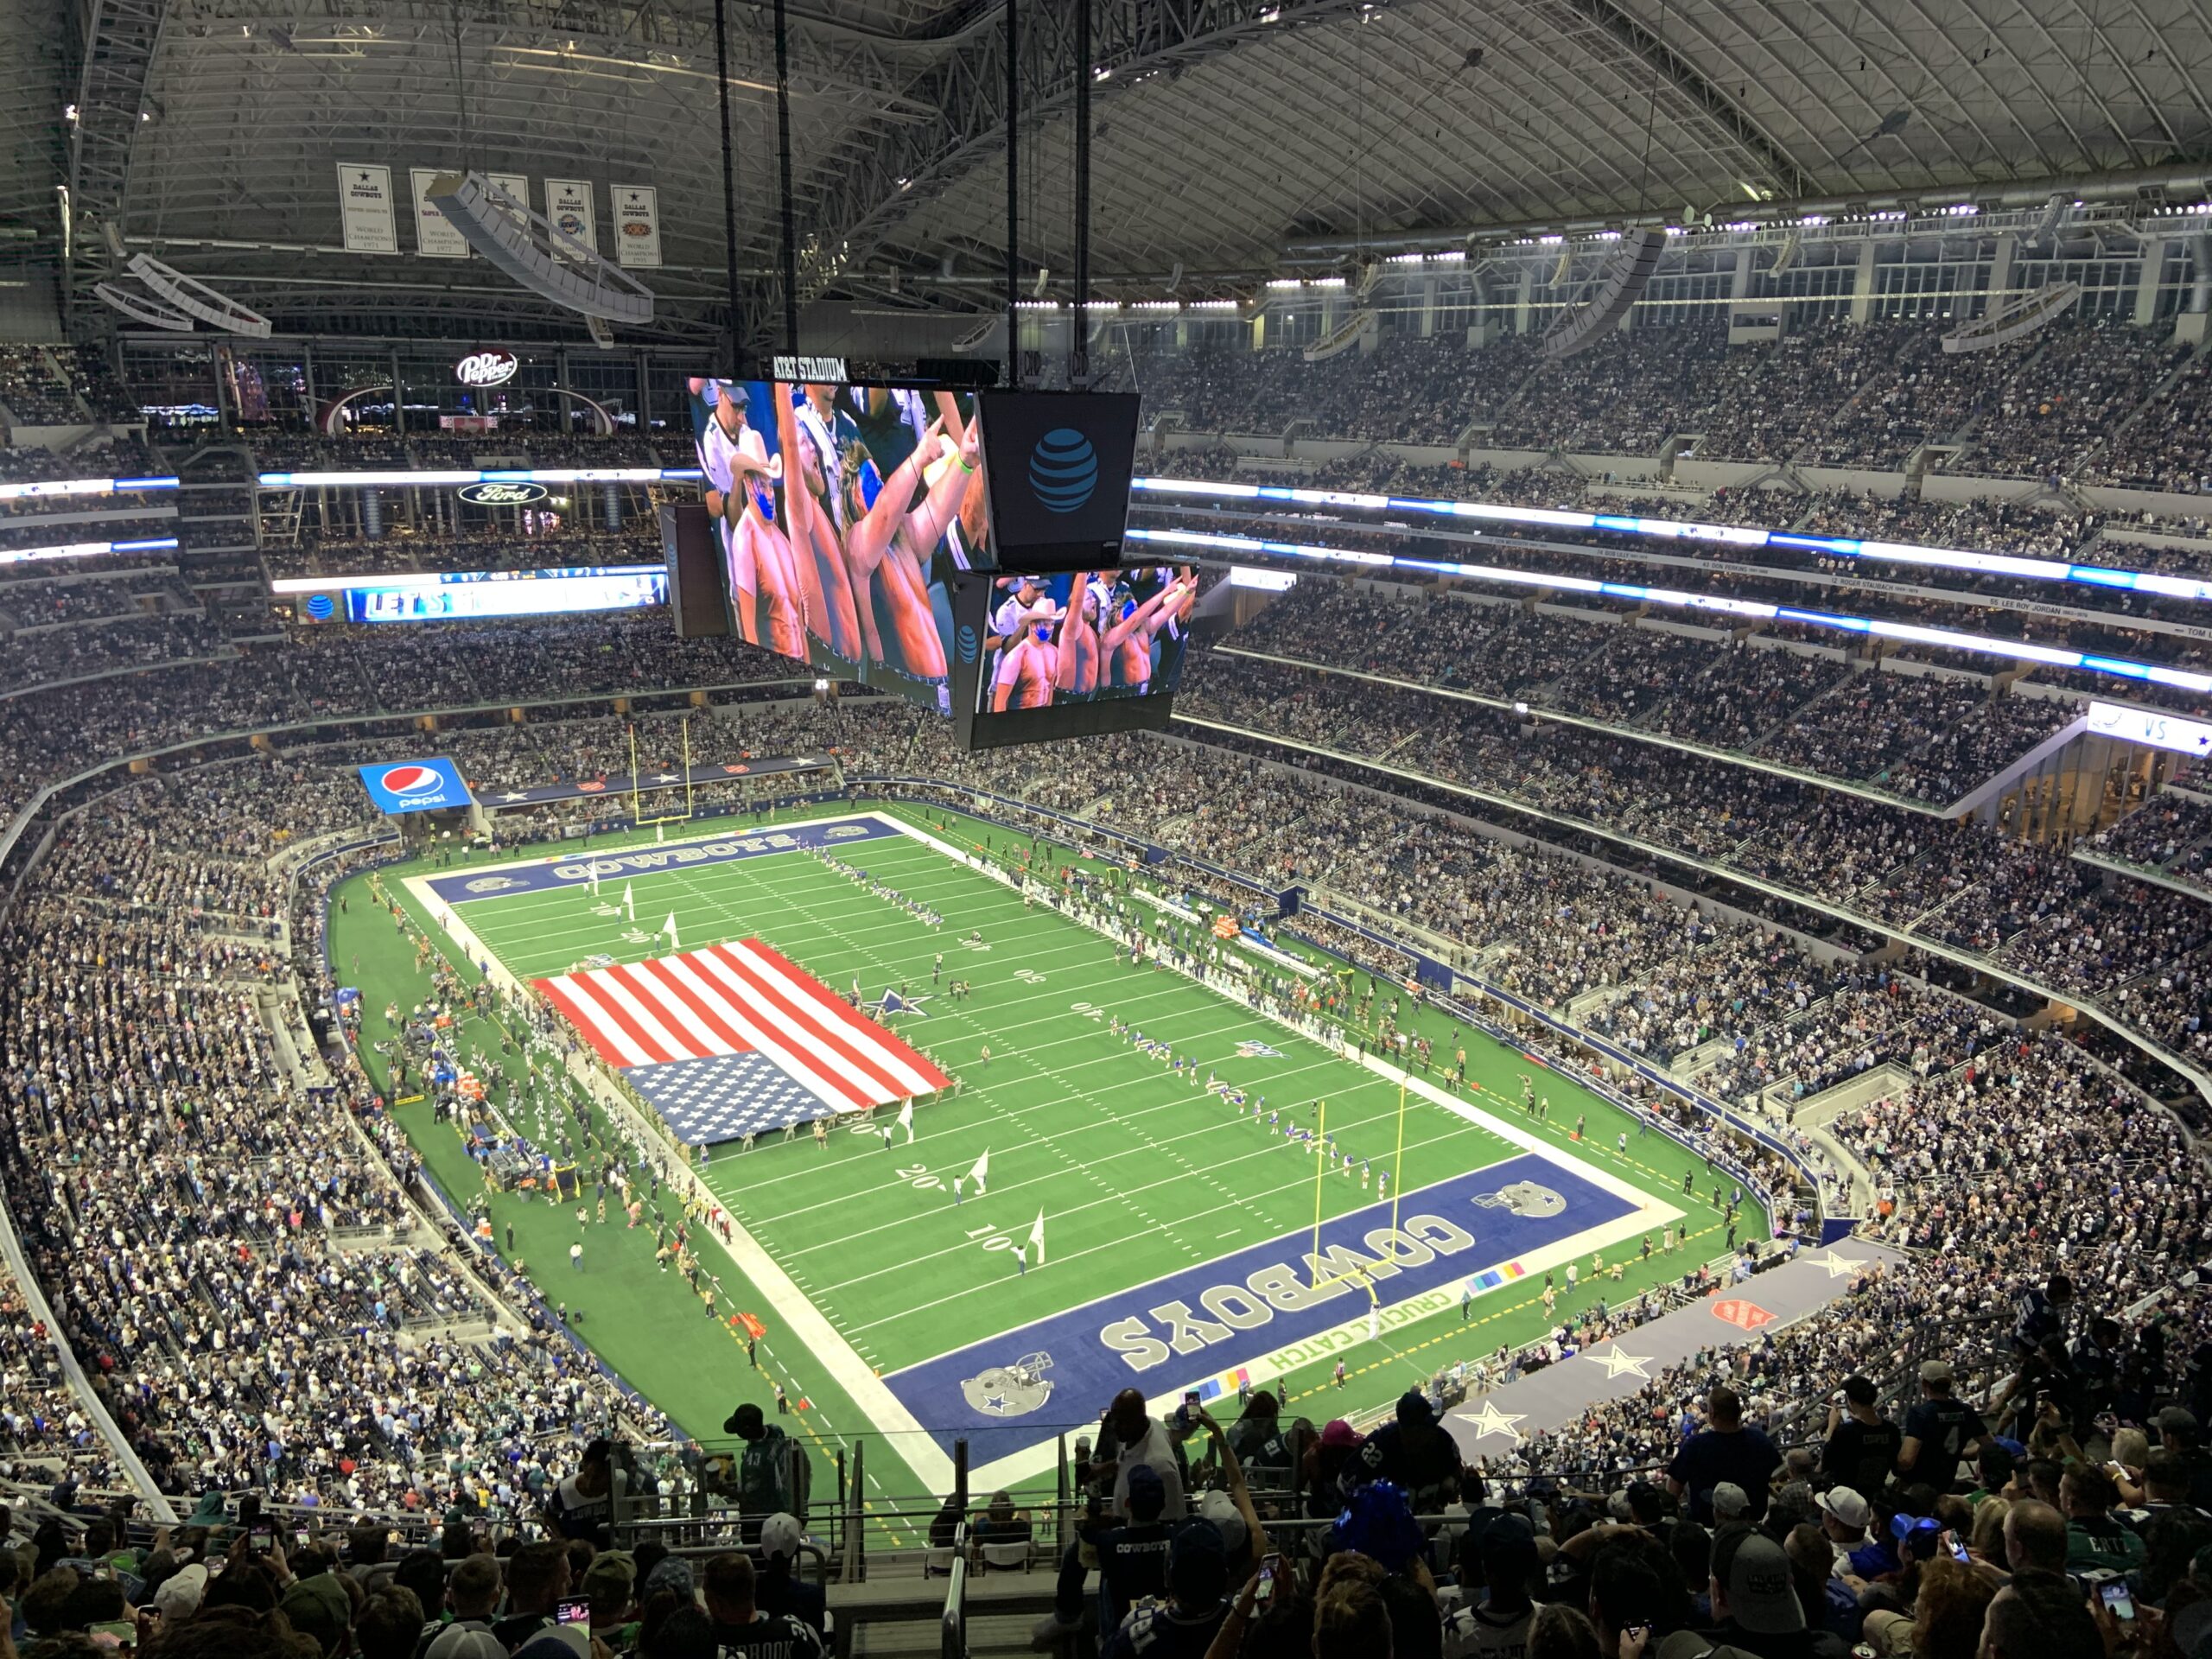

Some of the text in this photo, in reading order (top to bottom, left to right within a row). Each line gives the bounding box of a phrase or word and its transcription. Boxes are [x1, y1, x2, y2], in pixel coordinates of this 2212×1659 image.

[348, 233, 392, 242] CHAMPIONS
[423, 238, 464, 246] CHAMPIONS
[480, 353, 501, 367] Dr
[463, 356, 513, 383] Pepper
[773, 356, 848, 381] AT&T STADIUM
[476, 485, 531, 500] Ford
[1724, 563, 1747, 573] PERKINS
[1840, 578, 1861, 587] ROGER
[1862, 581, 1893, 591] STAUBACH
[2001, 600, 2014, 608] LEE
[2016, 601, 2030, 610] ROY
[2031, 604, 2061, 614] JORDAN
[2188, 627, 2206, 637] TOM
[2145, 717, 2167, 740] VS
[398, 793, 446, 809] pepsi
[553, 834, 799, 880] COWBOYS
[1013, 969, 1047, 984] 50
[1070, 1001, 1105, 1016] 40
[895, 1163, 940, 1189] 20
[964, 1223, 1013, 1251] 10
[1099, 1214, 1476, 1374] COWBOYS
[1268, 1332, 1355, 1370] CATCH
[746, 1452, 762, 1466] 43
[1361, 1441, 1383, 1469] 22
[1116, 1539, 1171, 1554] COWBOYS
[2088, 1536, 2132, 1553] ERTZ
